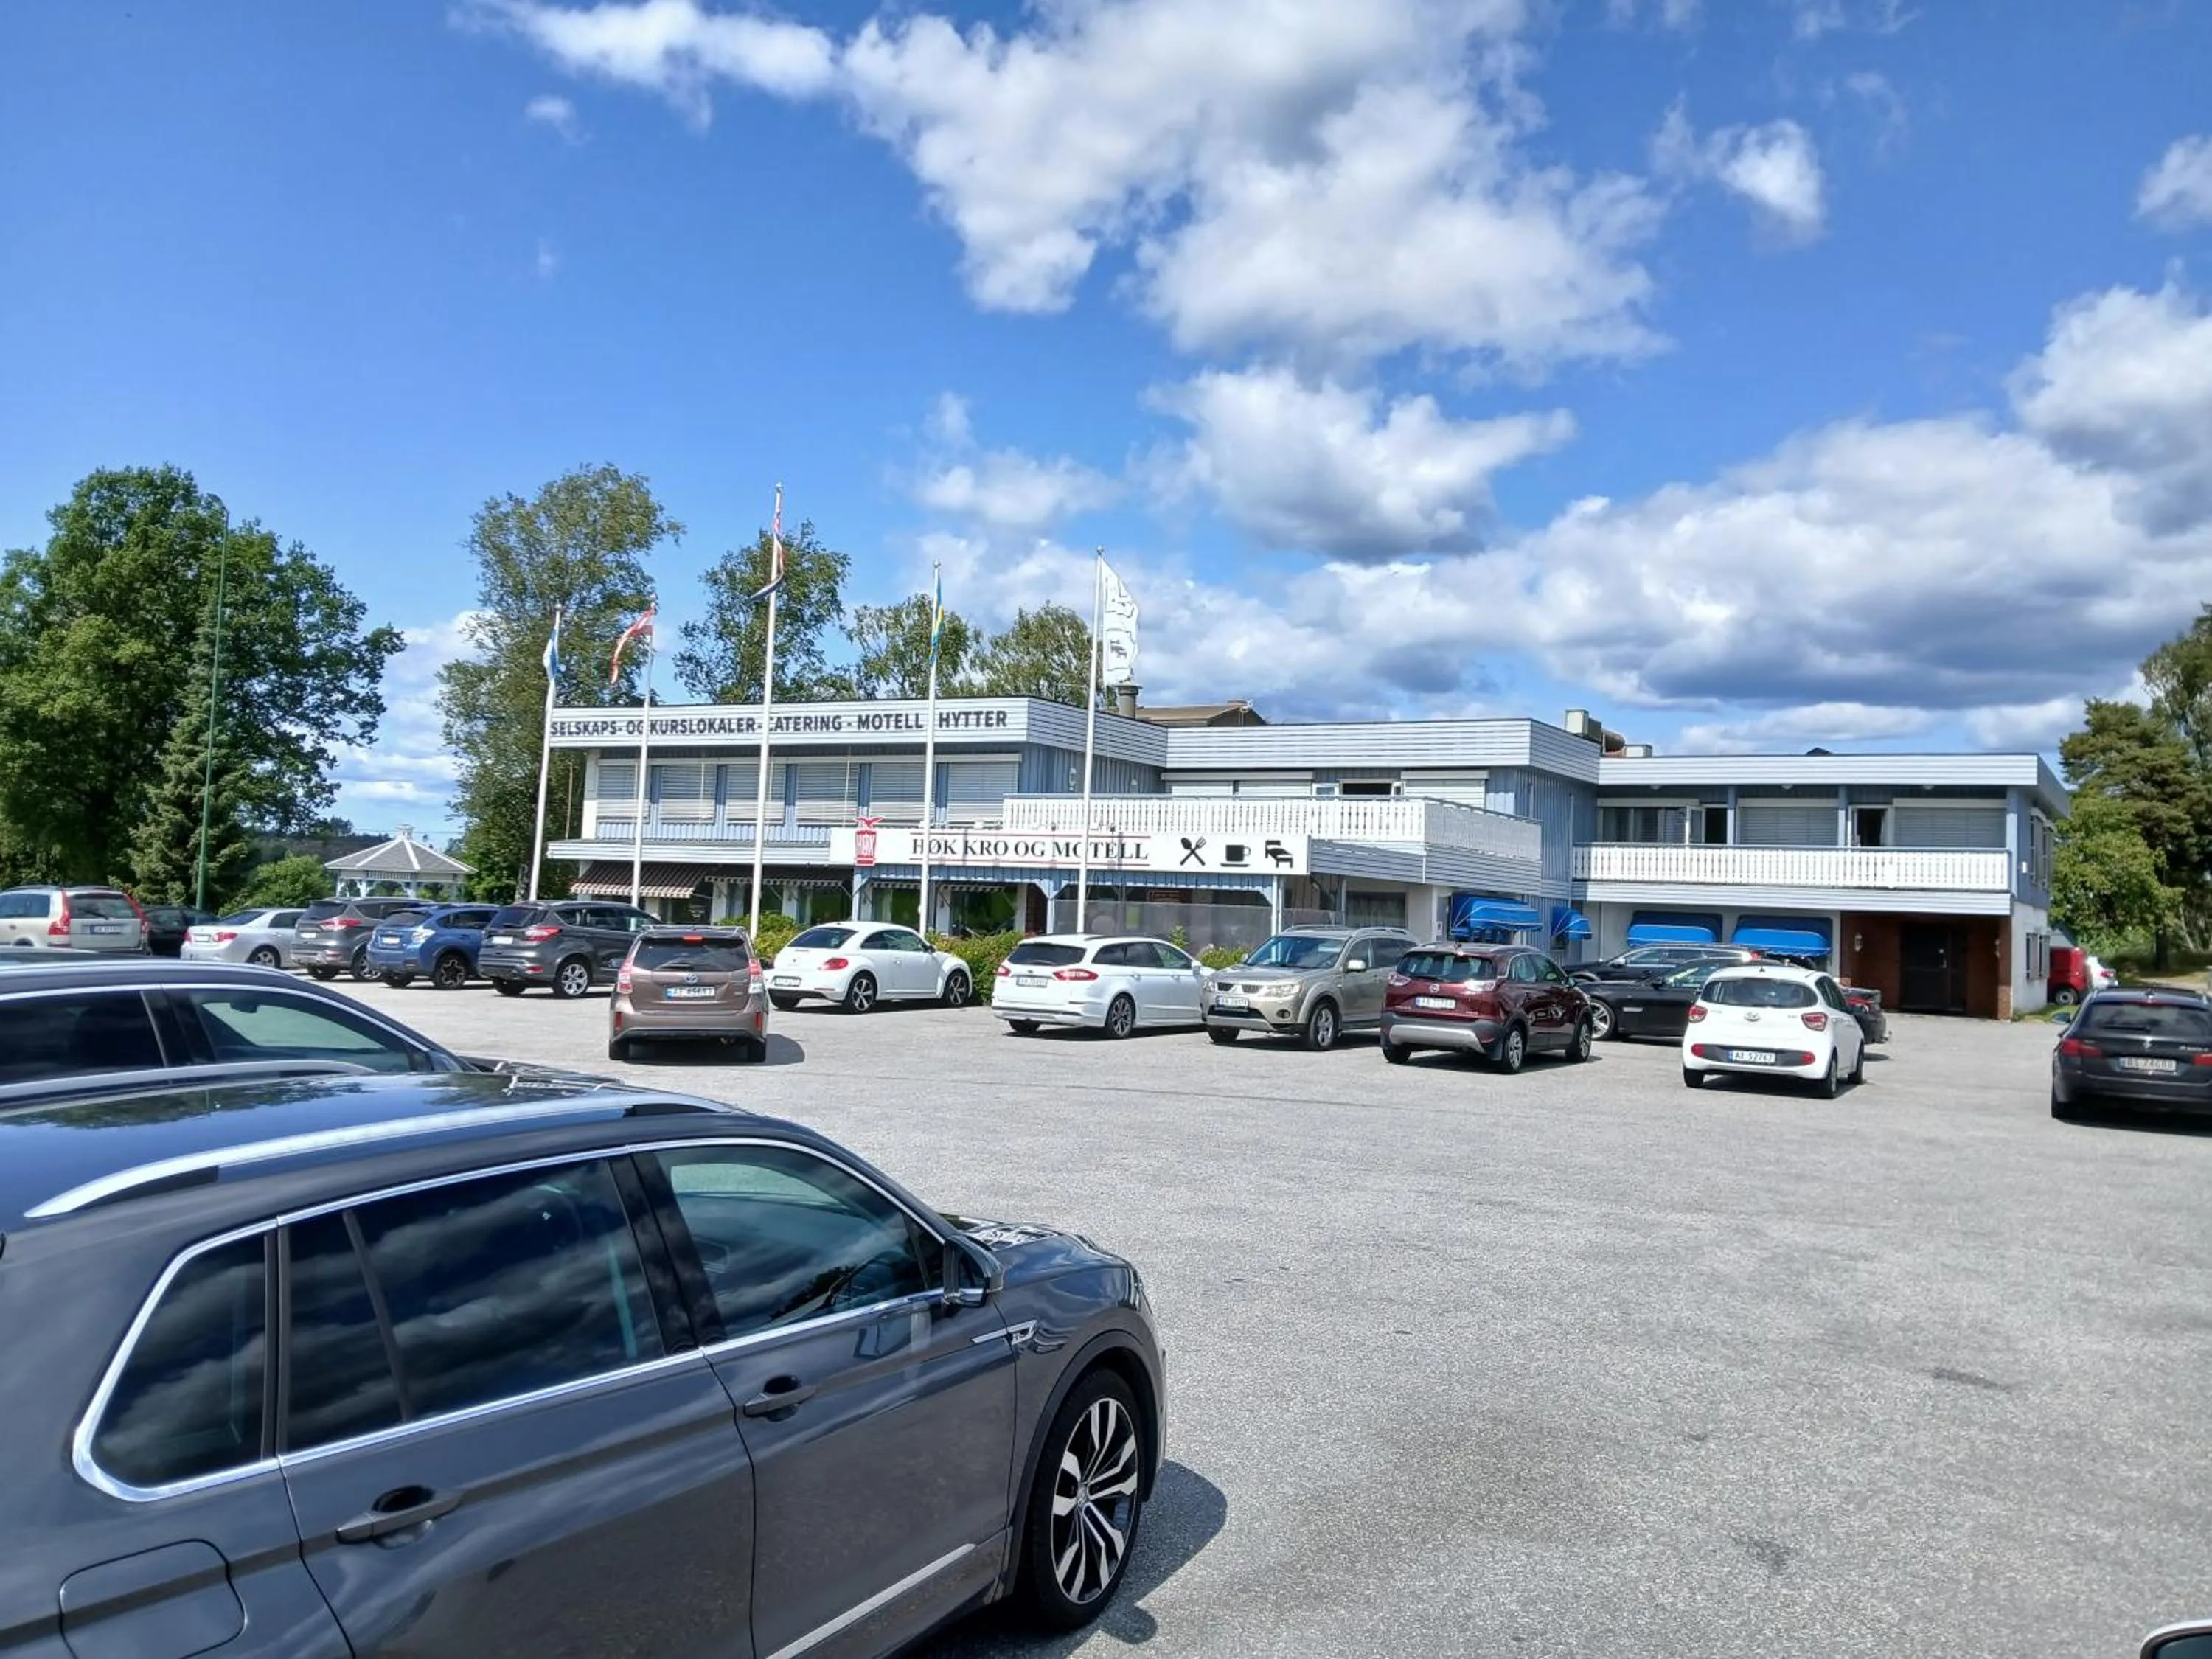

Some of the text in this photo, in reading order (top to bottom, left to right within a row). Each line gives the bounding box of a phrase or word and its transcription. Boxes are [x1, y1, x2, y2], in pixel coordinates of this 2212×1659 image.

[627, 719, 644, 735] OG
[857, 713, 924, 731] MOTELL
[938, 710, 1008, 728] HYTTER
[911, 838, 957, 855] HØK
[963, 838, 1009, 857] KRO
[1014, 840, 1046, 858] OG
